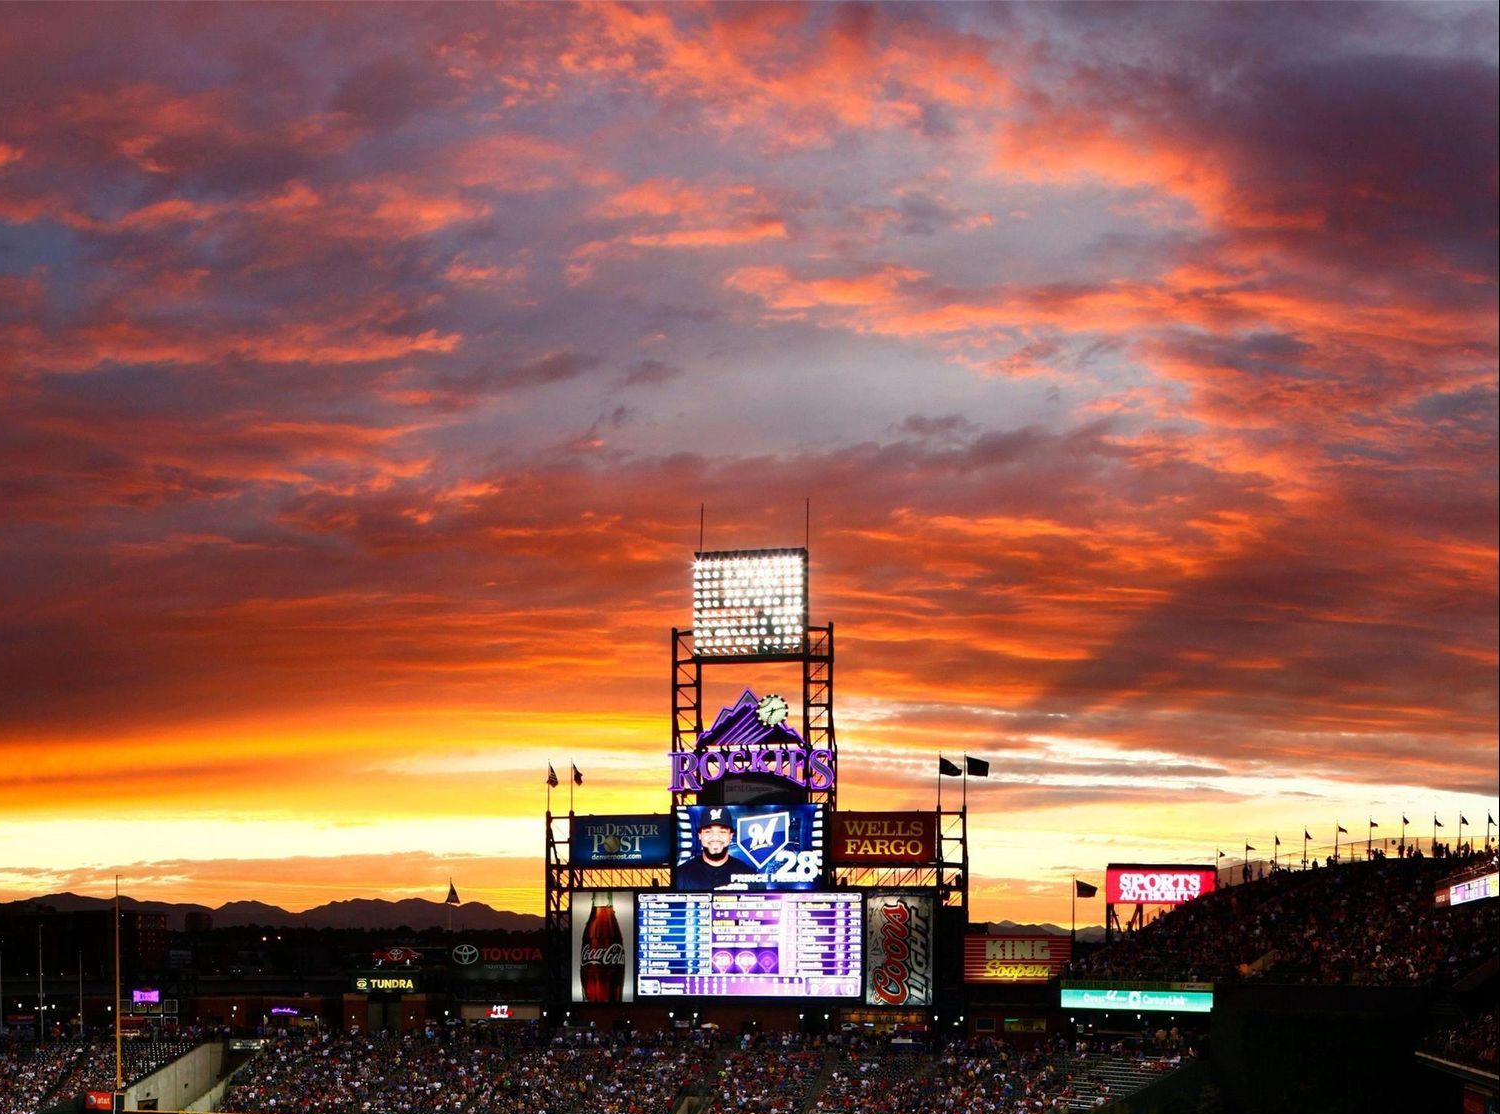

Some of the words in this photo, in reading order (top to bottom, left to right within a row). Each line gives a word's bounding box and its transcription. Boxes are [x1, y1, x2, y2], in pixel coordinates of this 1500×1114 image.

[668, 748, 835, 792] ROCKIES
[584, 825, 605, 836] THE
[604, 823, 659, 837] DENVER
[844, 820, 924, 837] WELLS
[844, 839, 923, 856] FARGO
[591, 853, 642, 861] denverpost.com
[774, 851, 819, 880] 28
[731, 874, 769, 883] PRINCE
[1119, 873, 1201, 890] SPORTS
[1119, 889, 1200, 901] AUTHORITY
[482, 948, 543, 961] TOYOTA
[580, 944, 626, 966] Coca-Cola
[873, 900, 909, 1005] Coors
[908, 906, 931, 1004] LIGHT
[985, 940, 1050, 960] KING
[370, 979, 413, 989] TUNDRA
